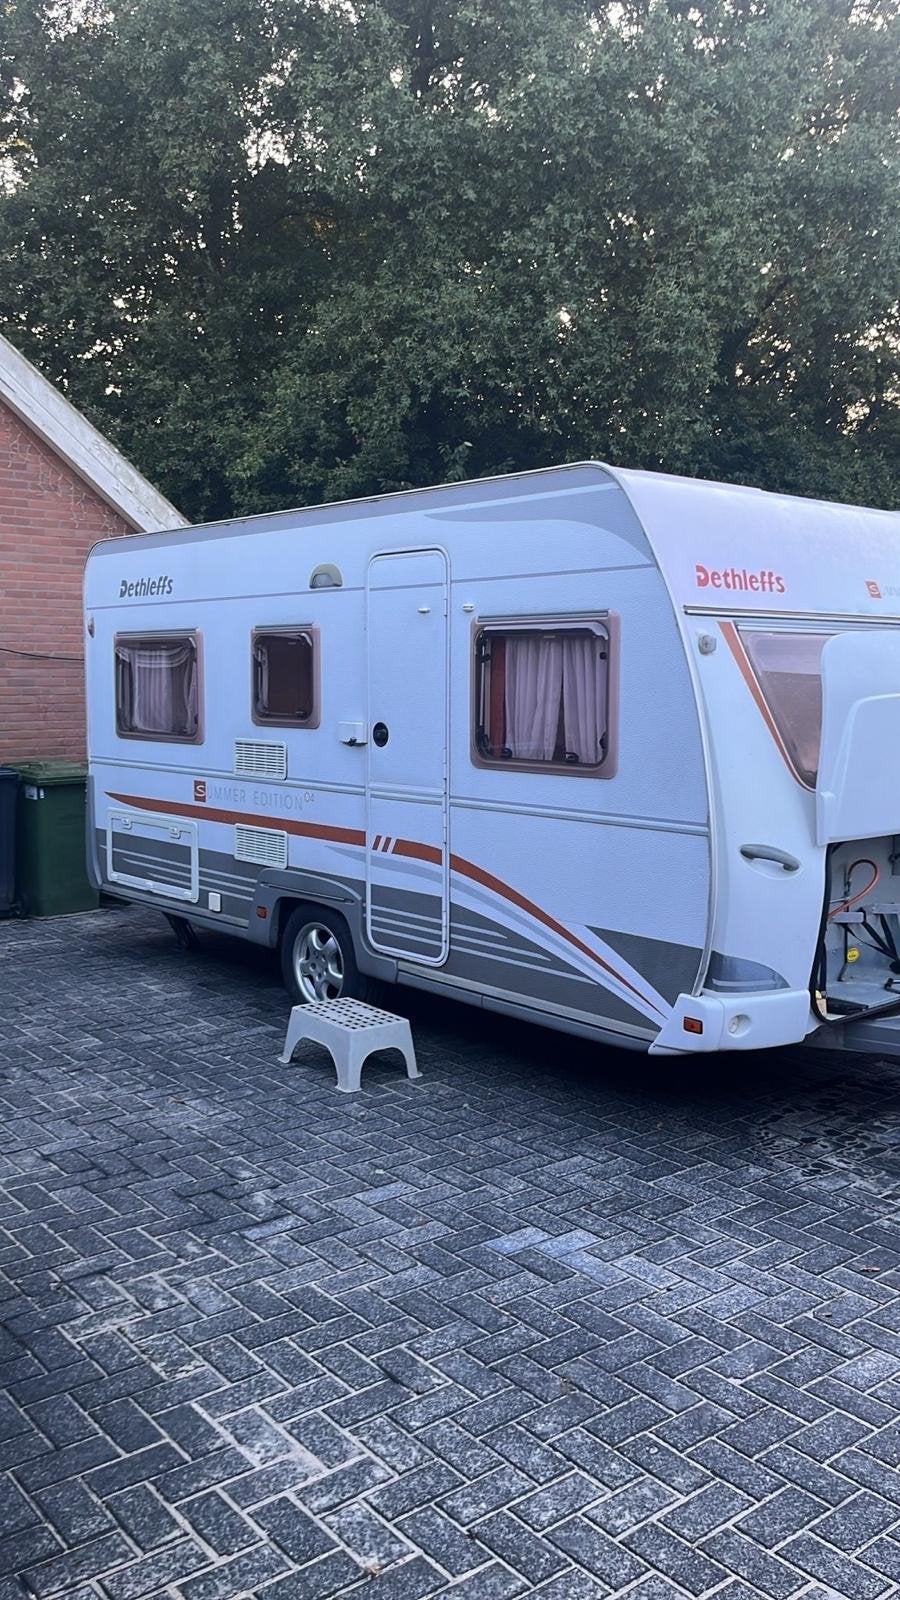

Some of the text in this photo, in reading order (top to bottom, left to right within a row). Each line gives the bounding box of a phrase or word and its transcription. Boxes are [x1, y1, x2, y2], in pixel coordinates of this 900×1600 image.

[119, 575, 174, 598] Dethleffs
[696, 565, 785, 593] Dethleffs
[194, 782, 246, 804] SUMMER
